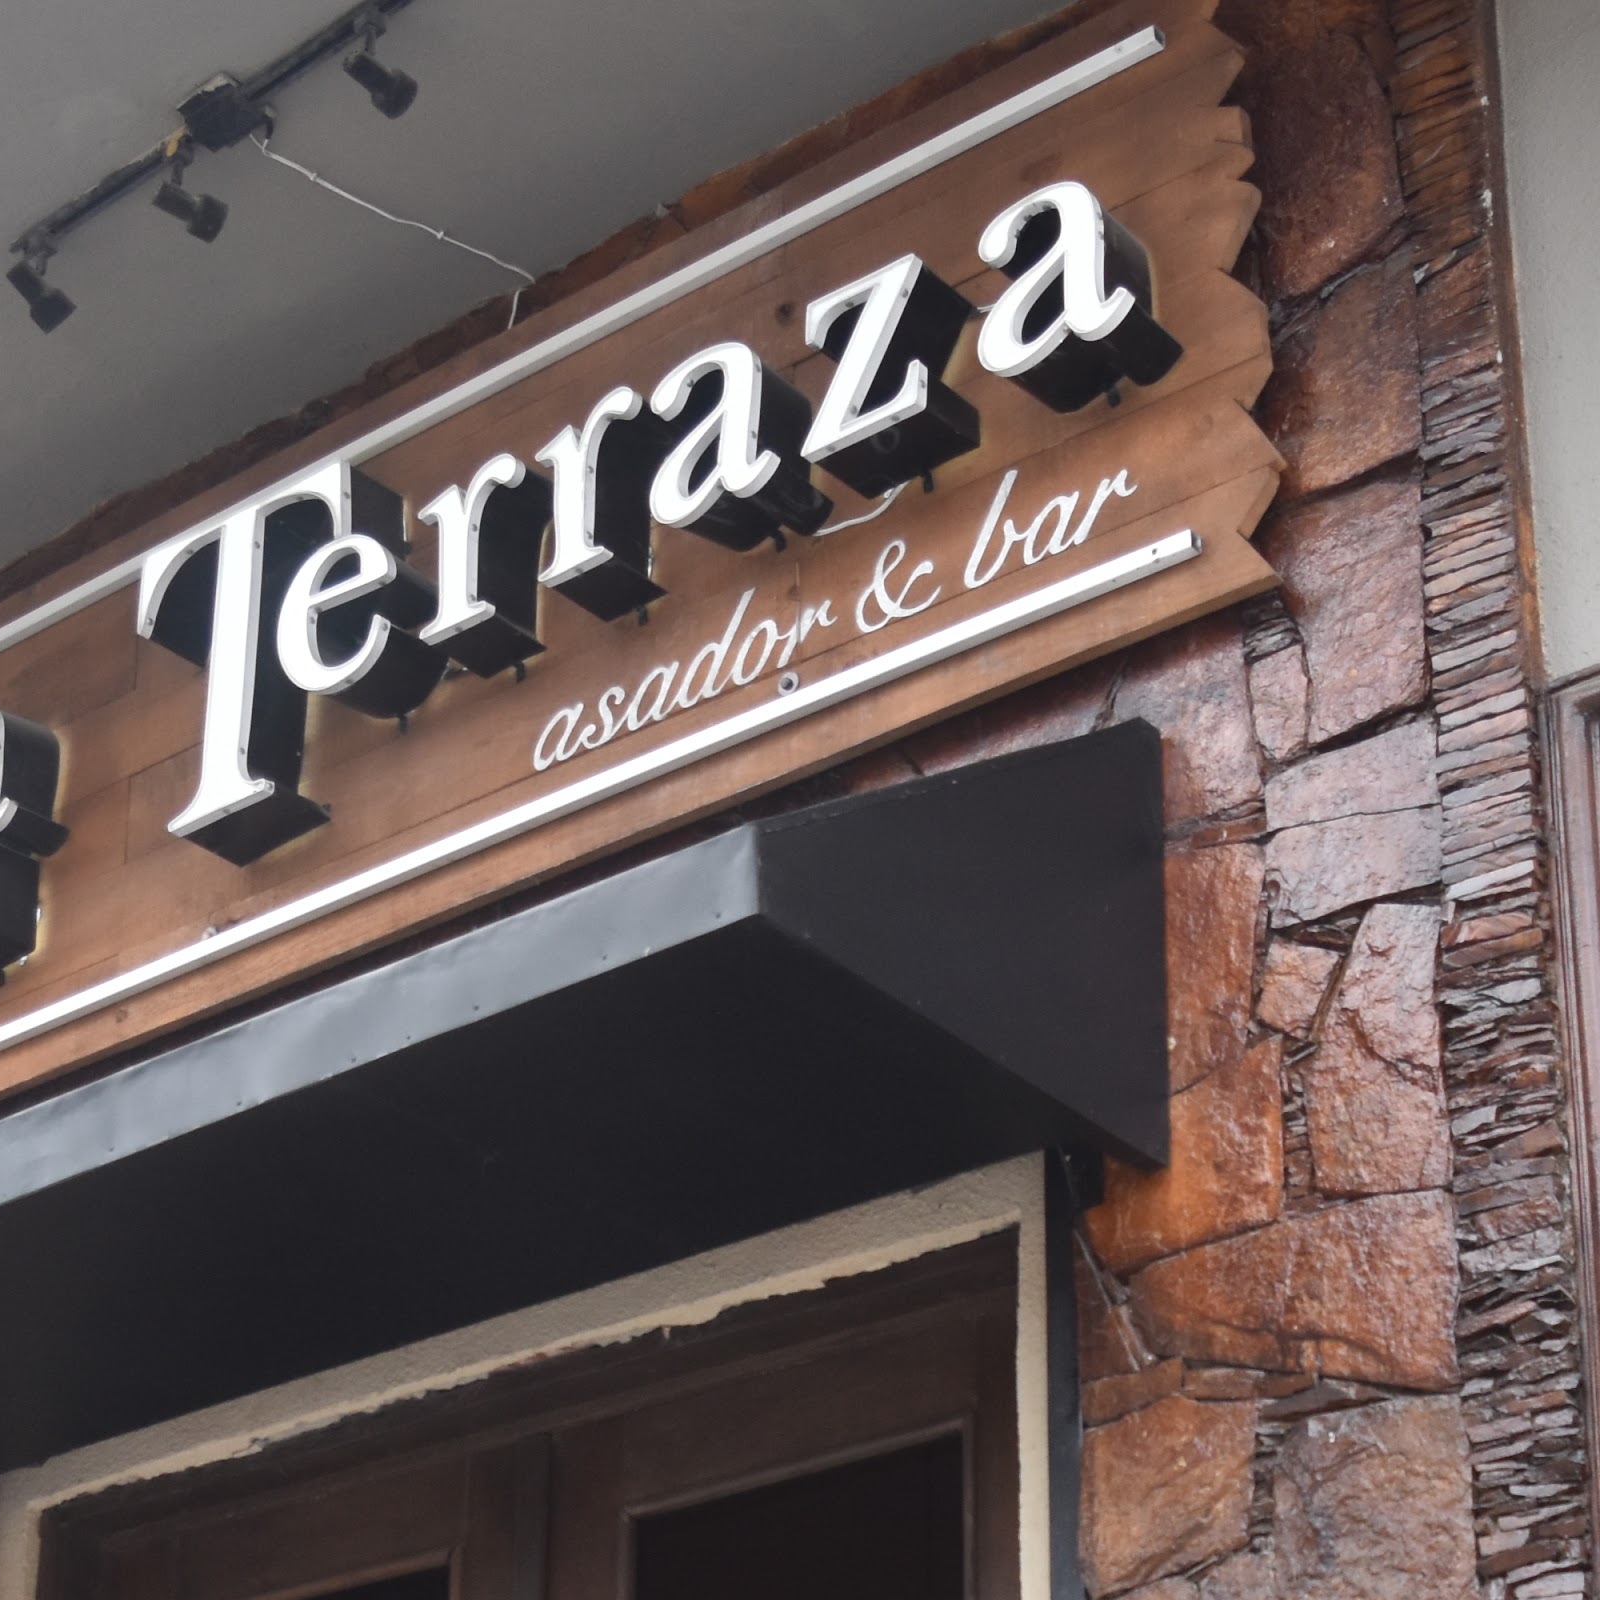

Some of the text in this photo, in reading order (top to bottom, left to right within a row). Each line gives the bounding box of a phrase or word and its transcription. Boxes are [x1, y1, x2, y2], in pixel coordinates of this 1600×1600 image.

[136, 180, 1138, 840] Terraza
[532, 468, 1138, 772] asador & bar
